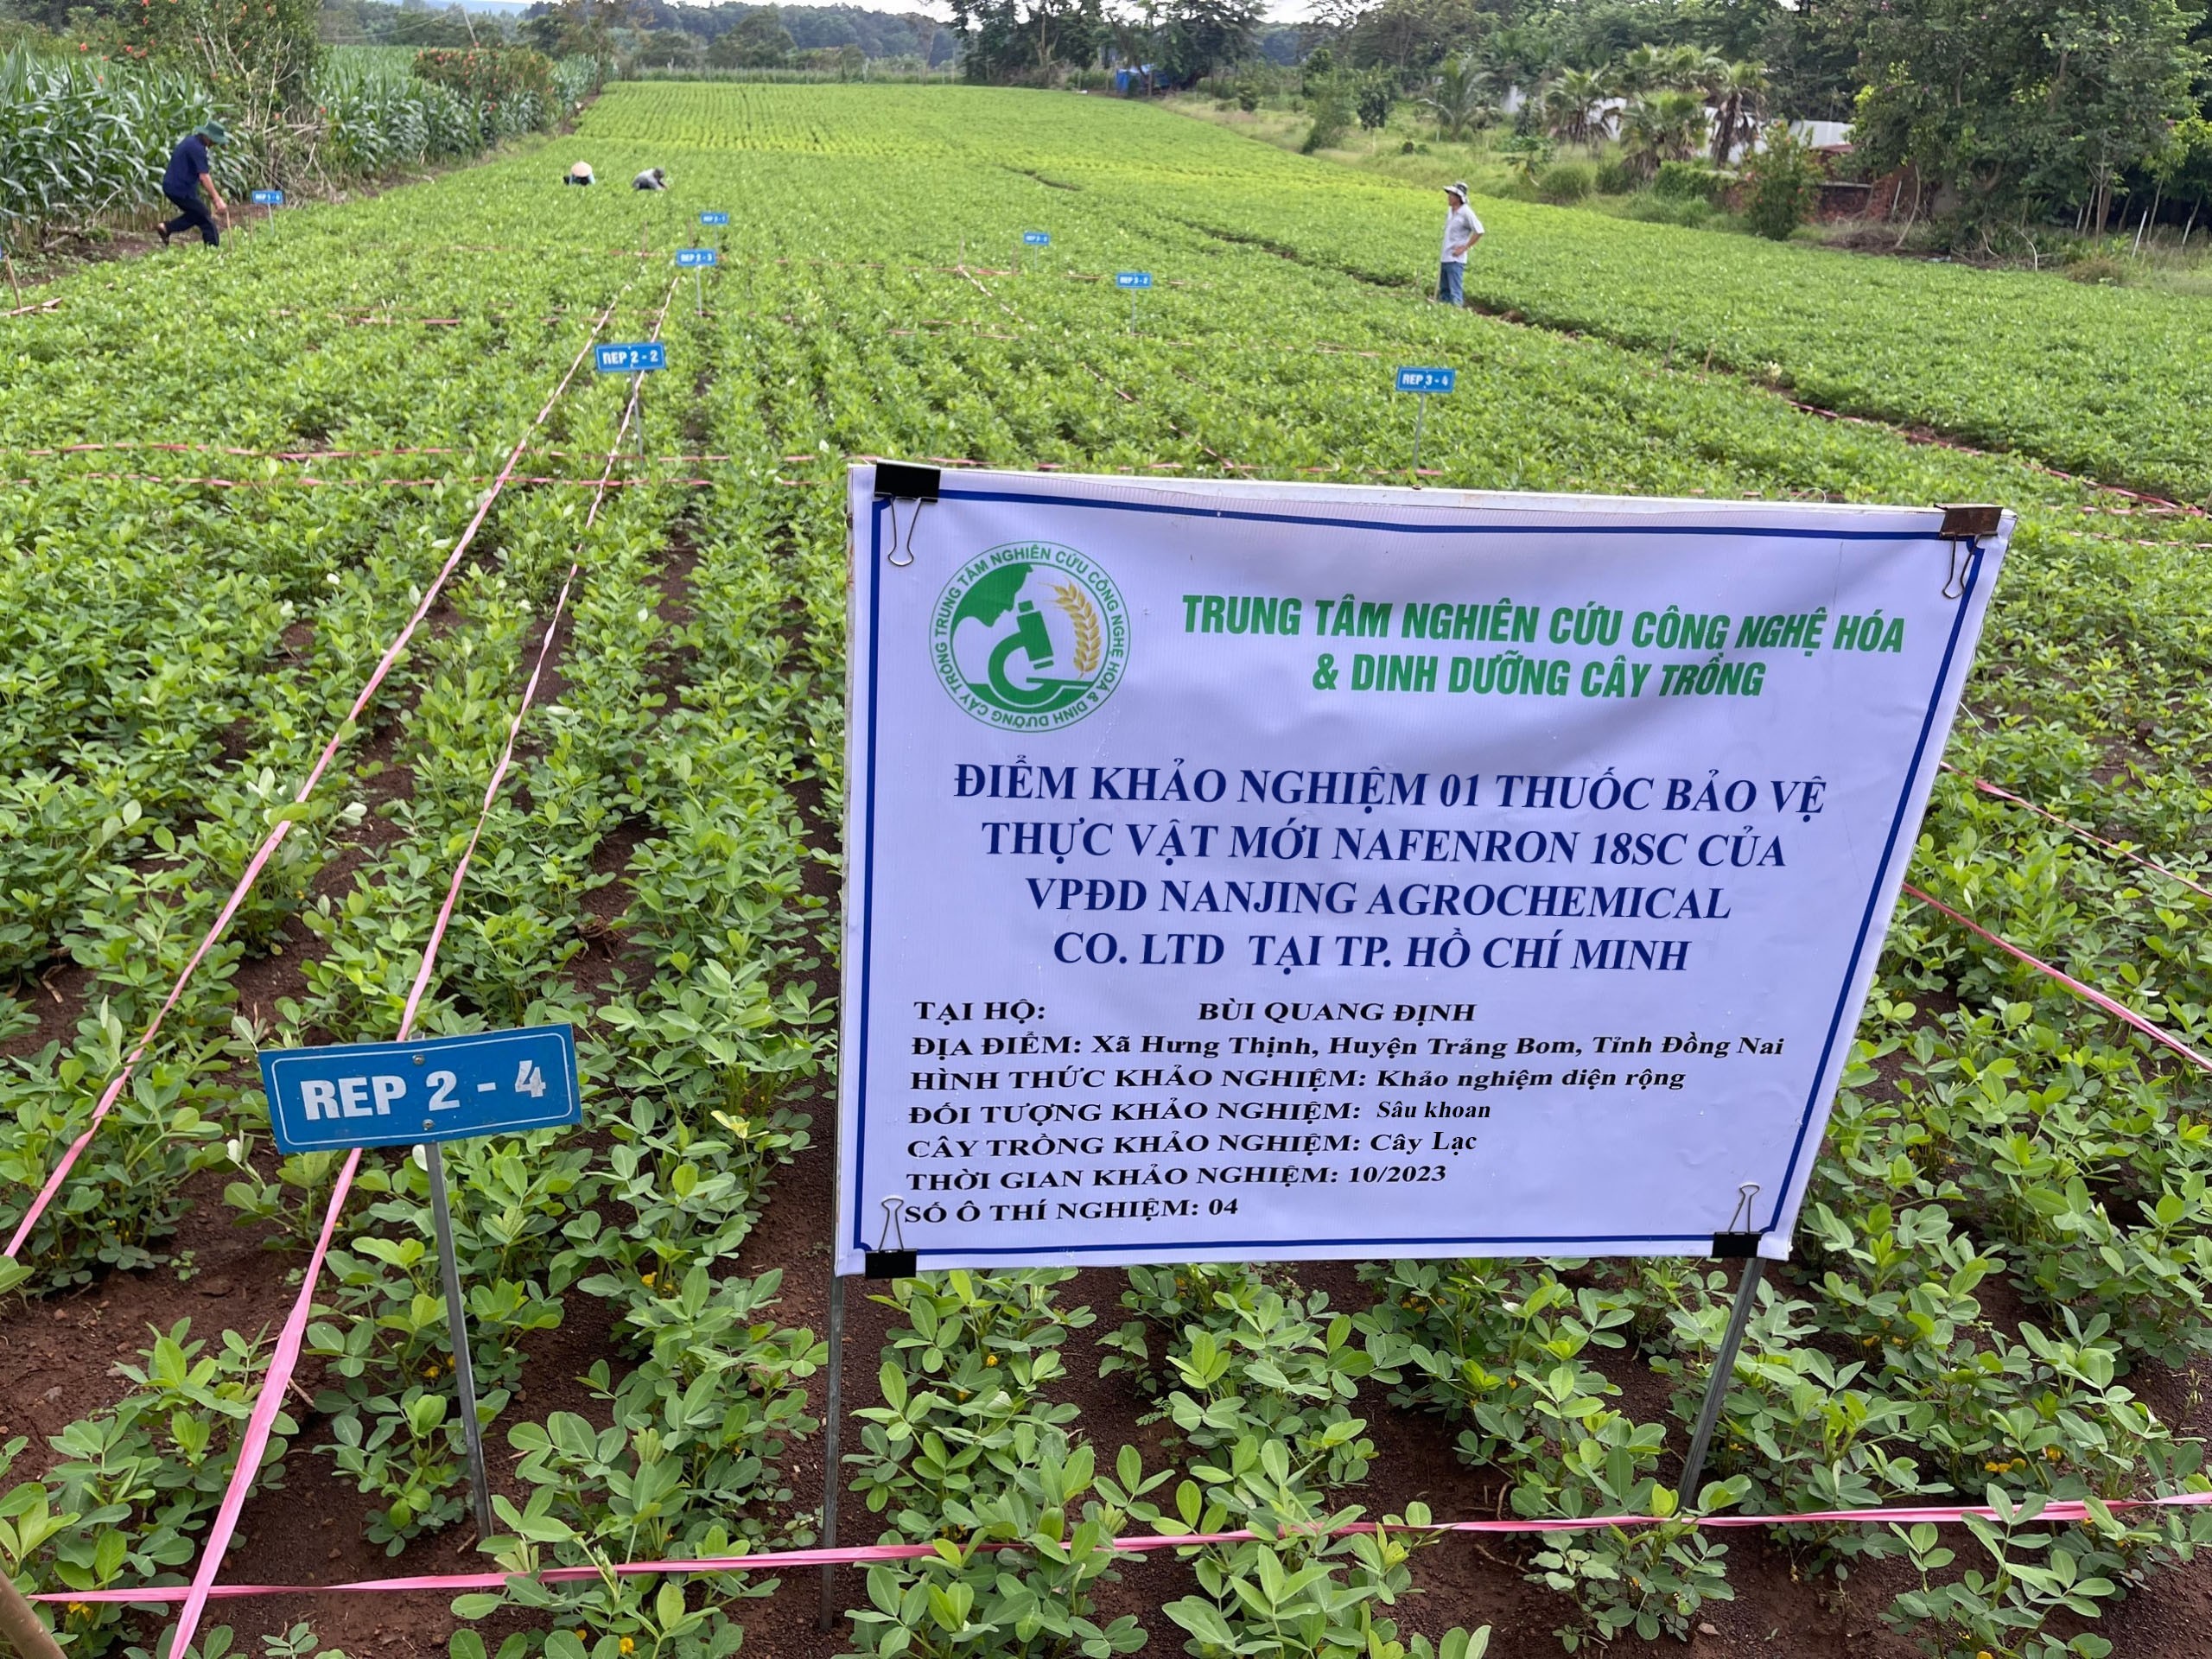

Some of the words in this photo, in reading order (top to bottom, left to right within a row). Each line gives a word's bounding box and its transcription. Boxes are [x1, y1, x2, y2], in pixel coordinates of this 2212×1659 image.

[602, 351, 627, 365] REP
[630, 350, 639, 364] 2
[650, 349, 658, 362] 2
[1402, 373, 1424, 385] REP
[1425, 374, 1433, 386] 3
[1441, 375, 1448, 386] 4
[989, 544, 1051, 566] NGHIÊN
[1055, 550, 1089, 575] CỨU
[957, 559, 989, 588] TÂM
[935, 587, 963, 637] TRUNG
[1182, 594, 1303, 636] TRUNG
[1314, 593, 1394, 638] TÂM
[1401, 597, 1541, 644] NGHIÊN
[1548, 601, 1624, 646] CỨU
[1631, 604, 1731, 651] CÔNG
[1733, 606, 1828, 658] NGHỆ
[1832, 608, 1905, 653] HÓA
[1312, 652, 1339, 690] &
[1351, 653, 1439, 693] DINH
[1447, 649, 1571, 696] DƯỠNG
[1580, 654, 1653, 698] CÂY
[1658, 651, 1767, 697] TRỒNG
[959, 694, 989, 716] CÂY
[1052, 699, 1089, 725] DINH
[1087, 692, 1099, 703] &
[990, 710, 1049, 728] DƯỠNG
[953, 754, 1079, 800] ĐIỂM
[1088, 757, 1227, 803] KHẢO
[1236, 766, 1431, 815] NGHIỆM
[1440, 773, 1480, 808] 01
[1495, 766, 1655, 811] THUỐC
[1661, 768, 1758, 813] BẢO
[1770, 775, 1827, 823] VỆ
[981, 817, 1114, 865] THỰC
[1124, 818, 1219, 867] VẬT
[1227, 817, 1323, 861] MỚI
[1331, 827, 1581, 864] NAFENRON
[1589, 832, 1688, 866] 18SC
[1697, 824, 1786, 868] CỦA
[1025, 877, 1147, 912] VPĐD
[1158, 880, 1358, 914] NANJING
[1363, 883, 1732, 919] AGROCHEMICAL
[1053, 931, 1128, 964] CO.
[1138, 933, 1224, 965] LTD
[1248, 935, 1325, 976] TẠI
[1335, 936, 1391, 968] TP.
[1402, 927, 1471, 969] HỒ
[1483, 928, 1564, 969] CHÍ
[1569, 938, 1693, 971] MINH
[913, 1001, 974, 1022] TẠI
[983, 998, 1046, 1025] HỘ:
[1197, 997, 1256, 1021] BÙI
[1264, 1001, 1385, 1024] QUANG
[1392, 1003, 1478, 1027] ĐỊNH
[911, 1037, 974, 1061] ĐỊA
[981, 1031, 1081, 1056] ĐIỂM:
[1090, 1035, 1131, 1053] Xã
[1139, 1035, 1221, 1059] Hưng
[1228, 1036, 1319, 1058] Thịnh,
[1326, 1036, 1417, 1059] Huyện
[1427, 1038, 1509, 1060] Trảng
[1514, 1037, 1583, 1058] Bom,
[1592, 1036, 1652, 1053] Tỉnh
[1659, 1031, 1732, 1058] Đồng
[1735, 1036, 1785, 1055] Nai
[301, 1075, 406, 1121] REP
[426, 1071, 460, 1111] 2
[515, 1060, 546, 1097] 4
[910, 1067, 1001, 1090] HÌNH
[1007, 1065, 1106, 1090] THỨC
[1114, 1064, 1213, 1087] KHẢO
[1220, 1067, 1366, 1093] NGHIỆM:
[1375, 1070, 1449, 1087] Khảo
[1456, 1069, 1553, 1091] nghiệm
[1561, 1068, 1617, 1090] diện
[1624, 1068, 1687, 1090] rộng
[908, 1102, 972, 1125] ĐỐI
[980, 1102, 1103, 1127] TƯỢNG
[1110, 1096, 1209, 1121] KHẢO
[1216, 1101, 1361, 1125] NGHIỆM:
[1376, 1100, 1417, 1118] Sâu
[1423, 1101, 1491, 1118] khoan
[907, 1135, 980, 1159] CÂY
[986, 1133, 1105, 1157] TRỒNG
[1112, 1130, 1210, 1154] KHẢO
[1217, 1133, 1361, 1157] NGHIỆM:
[1370, 1133, 1424, 1155] Cây
[1430, 1131, 1478, 1156] Lạc
[906, 1168, 992, 1191] THỜI
[1000, 1170, 1084, 1190] GIAN
[1092, 1163, 1188, 1186] KHẢO
[1196, 1165, 1338, 1188] NGHIỆM:
[1348, 1165, 1446, 1183] 10/2023
[904, 1201, 948, 1224] SỐ
[956, 1199, 981, 1223] Ô
[988, 1198, 1048, 1222] THÍ
[1055, 1198, 1198, 1222] NGHIỆM:
[1208, 1198, 1238, 1216] 04
